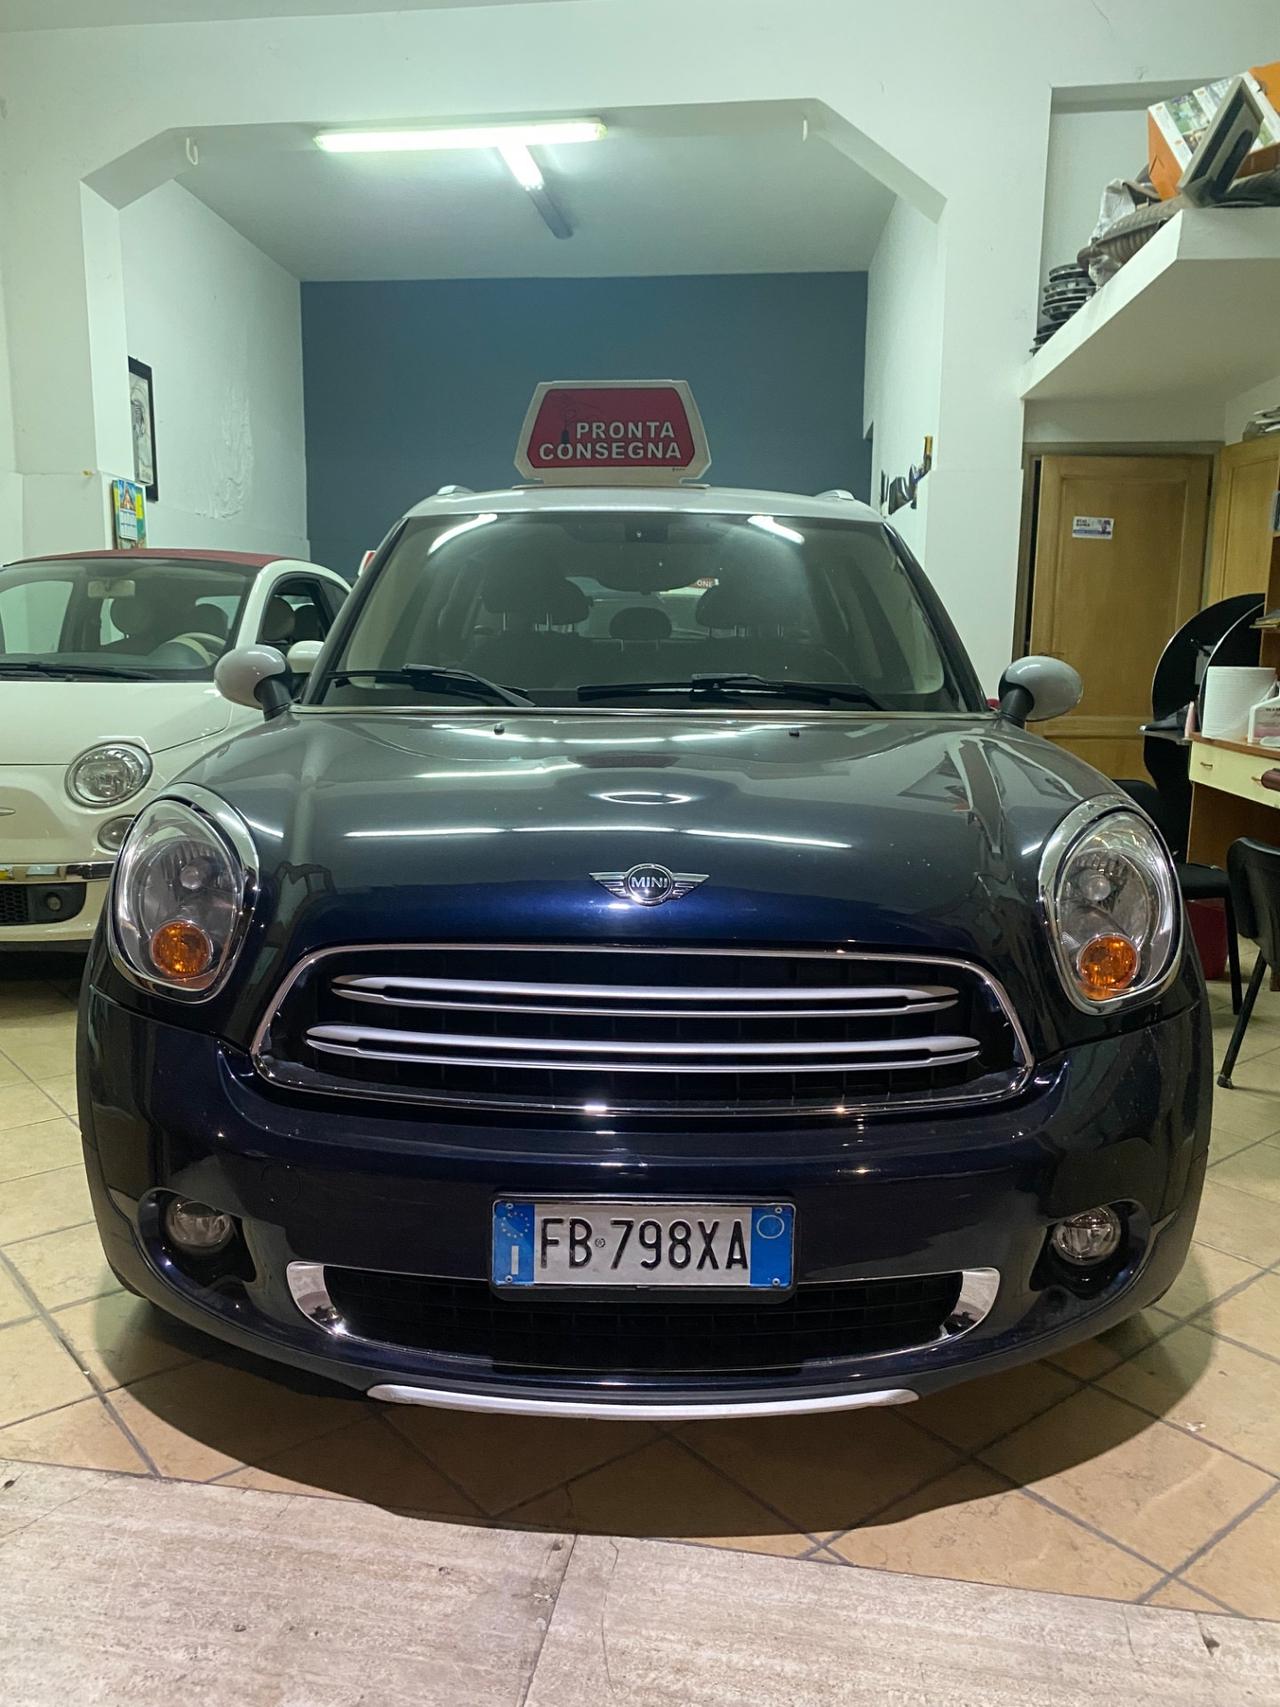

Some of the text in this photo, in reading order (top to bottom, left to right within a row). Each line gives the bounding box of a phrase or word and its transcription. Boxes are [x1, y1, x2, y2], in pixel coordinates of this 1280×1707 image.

[576, 421, 675, 439] PRONTA
[539, 441, 681, 460] CONSEGNA
[631, 876, 668, 888] MINI
